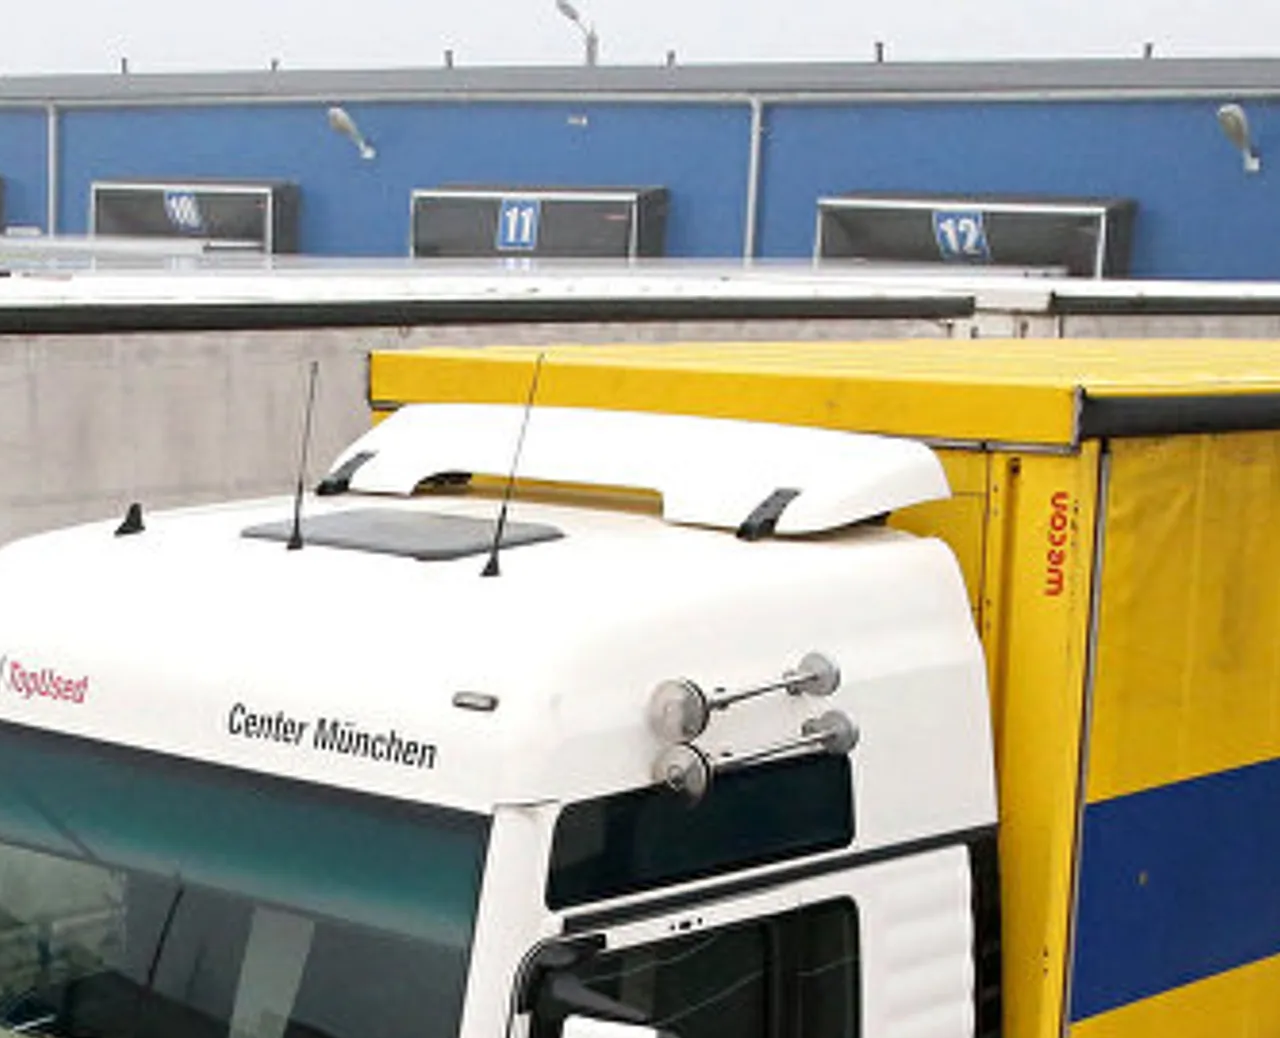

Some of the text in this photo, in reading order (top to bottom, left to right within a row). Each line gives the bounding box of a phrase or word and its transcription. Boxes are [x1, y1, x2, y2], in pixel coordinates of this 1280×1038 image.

[505, 206, 534, 243] 11
[939, 216, 982, 255] 12
[1042, 491, 1069, 597] wecon
[10, 660, 89, 704] TopUsed
[228, 702, 438, 769] Center München
